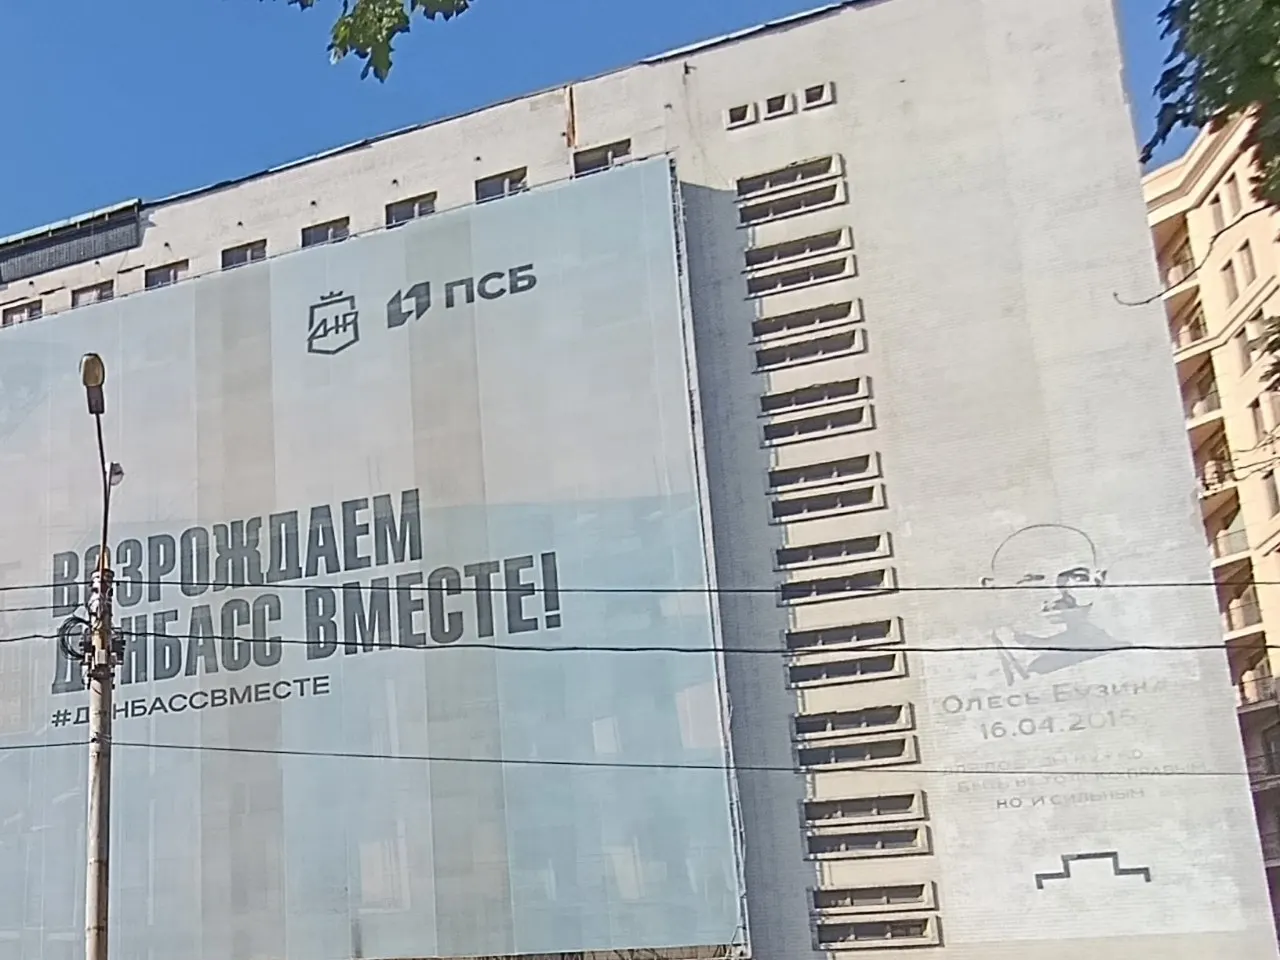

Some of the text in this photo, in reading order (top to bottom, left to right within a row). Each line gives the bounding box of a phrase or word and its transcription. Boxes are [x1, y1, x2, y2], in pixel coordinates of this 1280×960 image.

[445, 264, 537, 309] ПСБ
[51, 551, 563, 695] ДНБАСС ВМЕСТЕ!
[52, 675, 330, 729] #ДНБАССВМЕСТЕ
